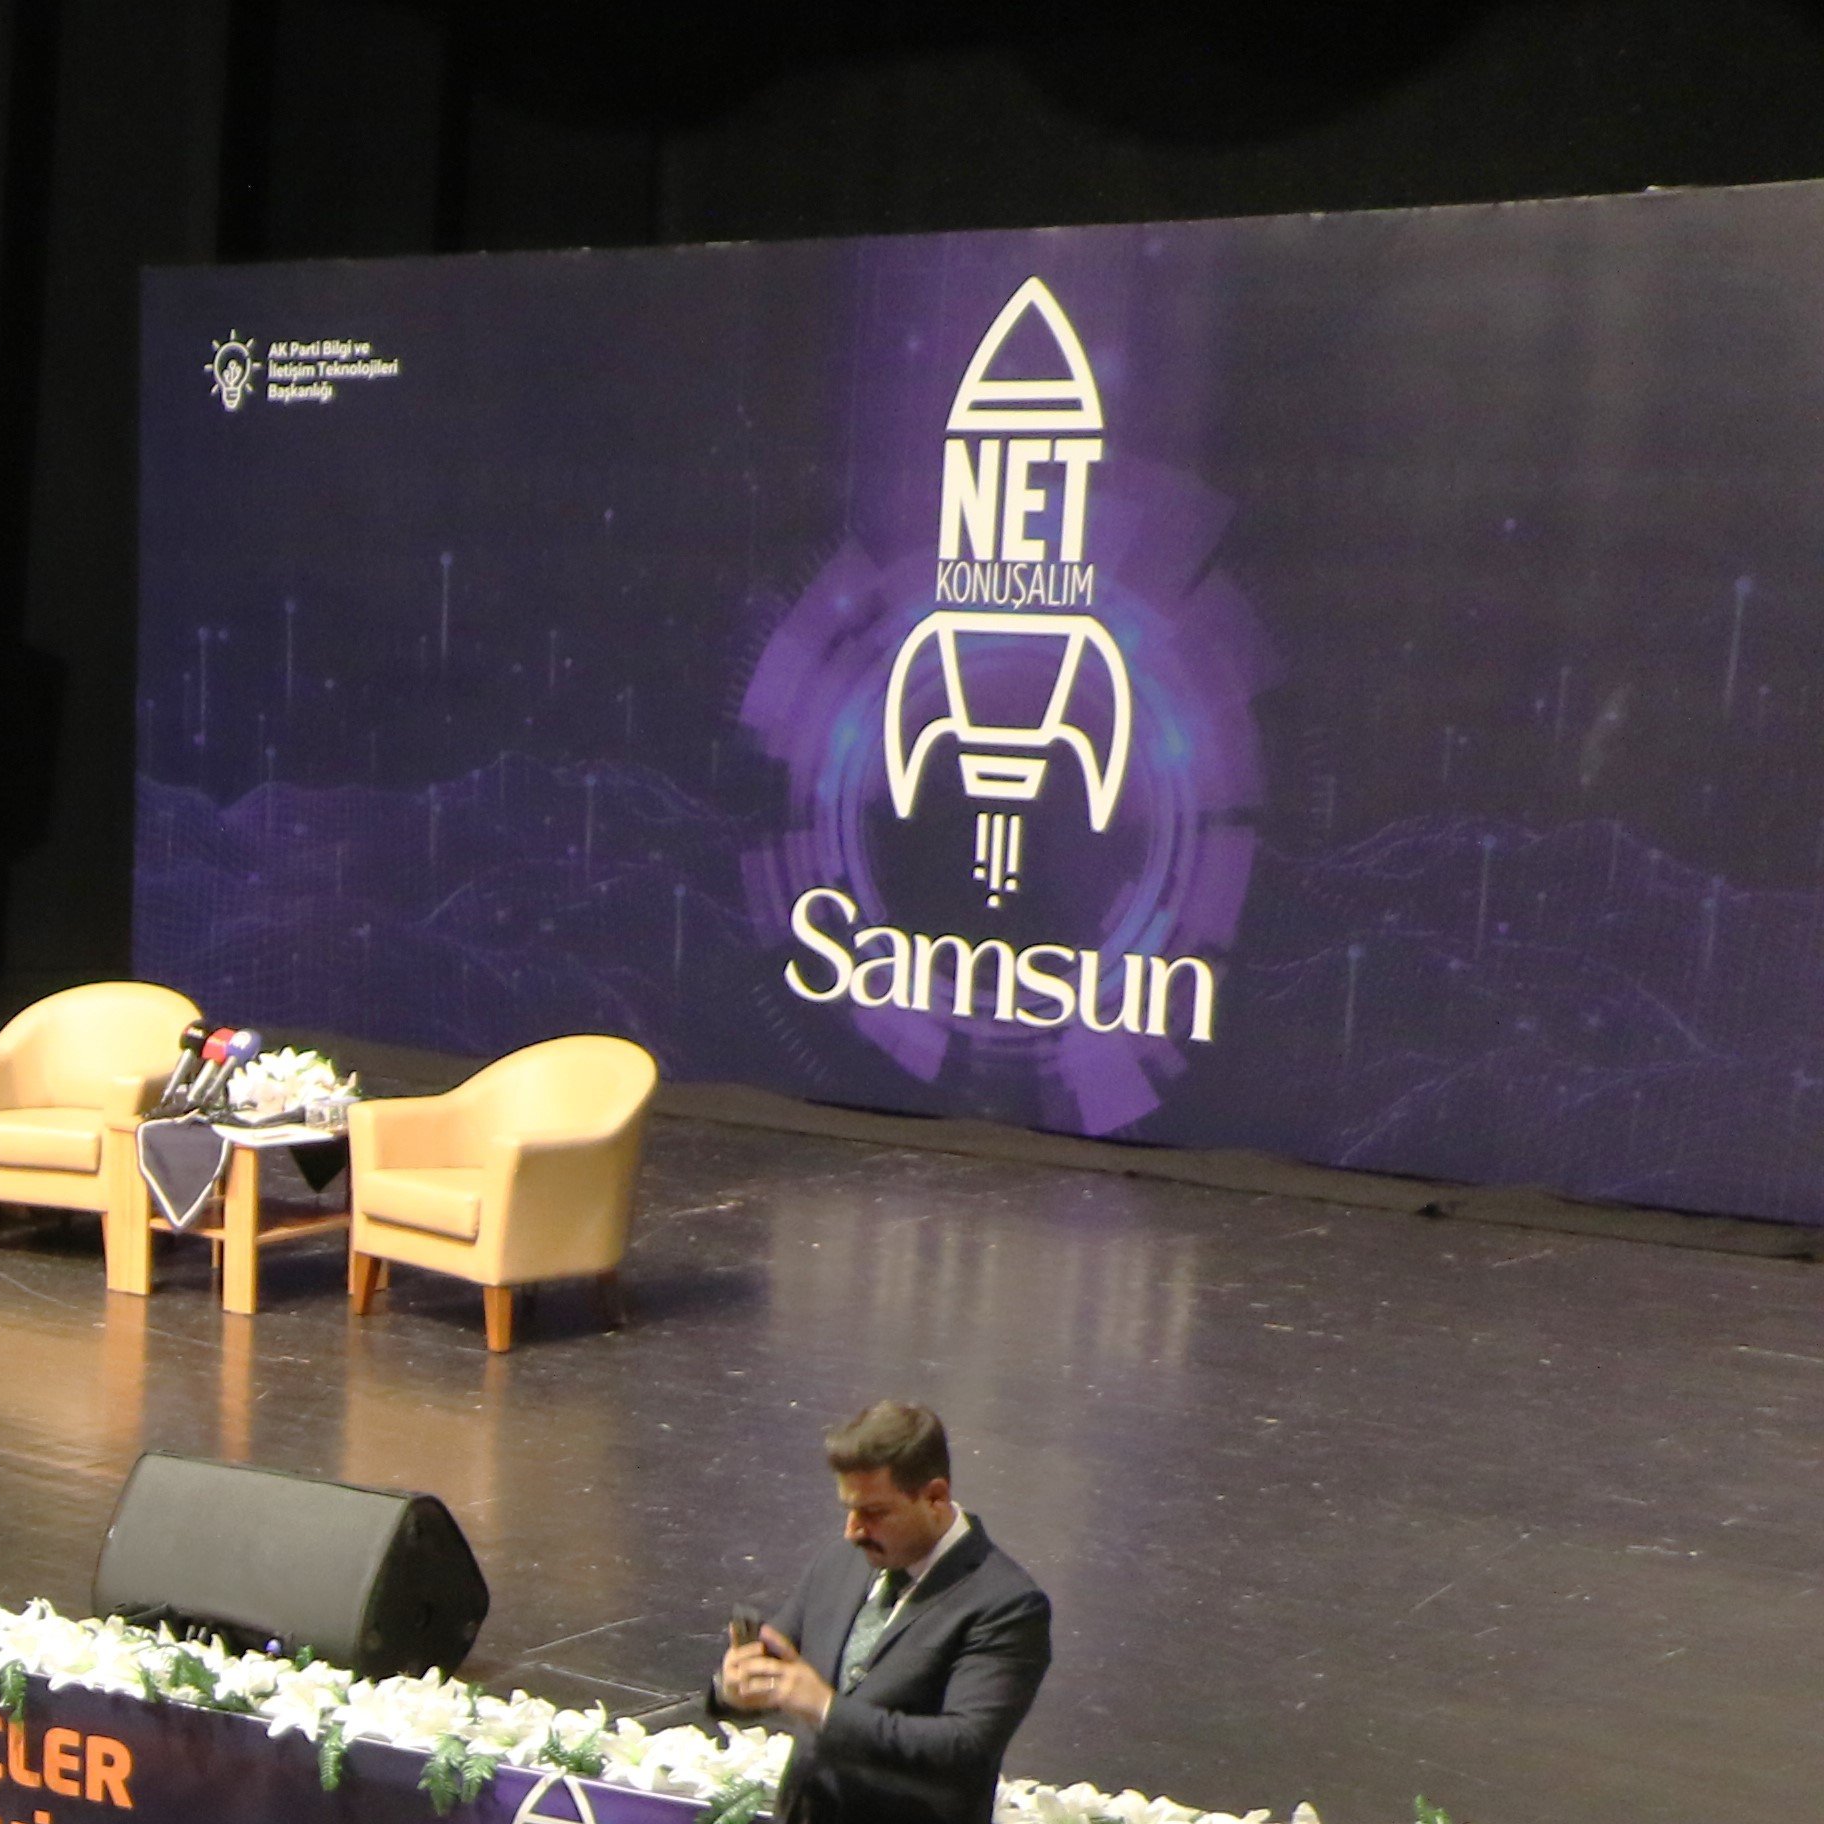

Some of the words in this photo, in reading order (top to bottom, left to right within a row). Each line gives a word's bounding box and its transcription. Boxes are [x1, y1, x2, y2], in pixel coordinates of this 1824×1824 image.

[268, 343, 288, 359] AK
[290, 341, 321, 358] Parti
[323, 340, 353, 359] Bilgi
[354, 342, 371, 355] ve
[268, 359, 315, 382] İletişim
[318, 358, 399, 380] Teknolojileri
[268, 381, 333, 402] Başkanlığı
[938, 438, 1102, 562] NET
[936, 561, 1094, 610] KONUŞALIM
[784, 887, 1215, 1043] Samsun
